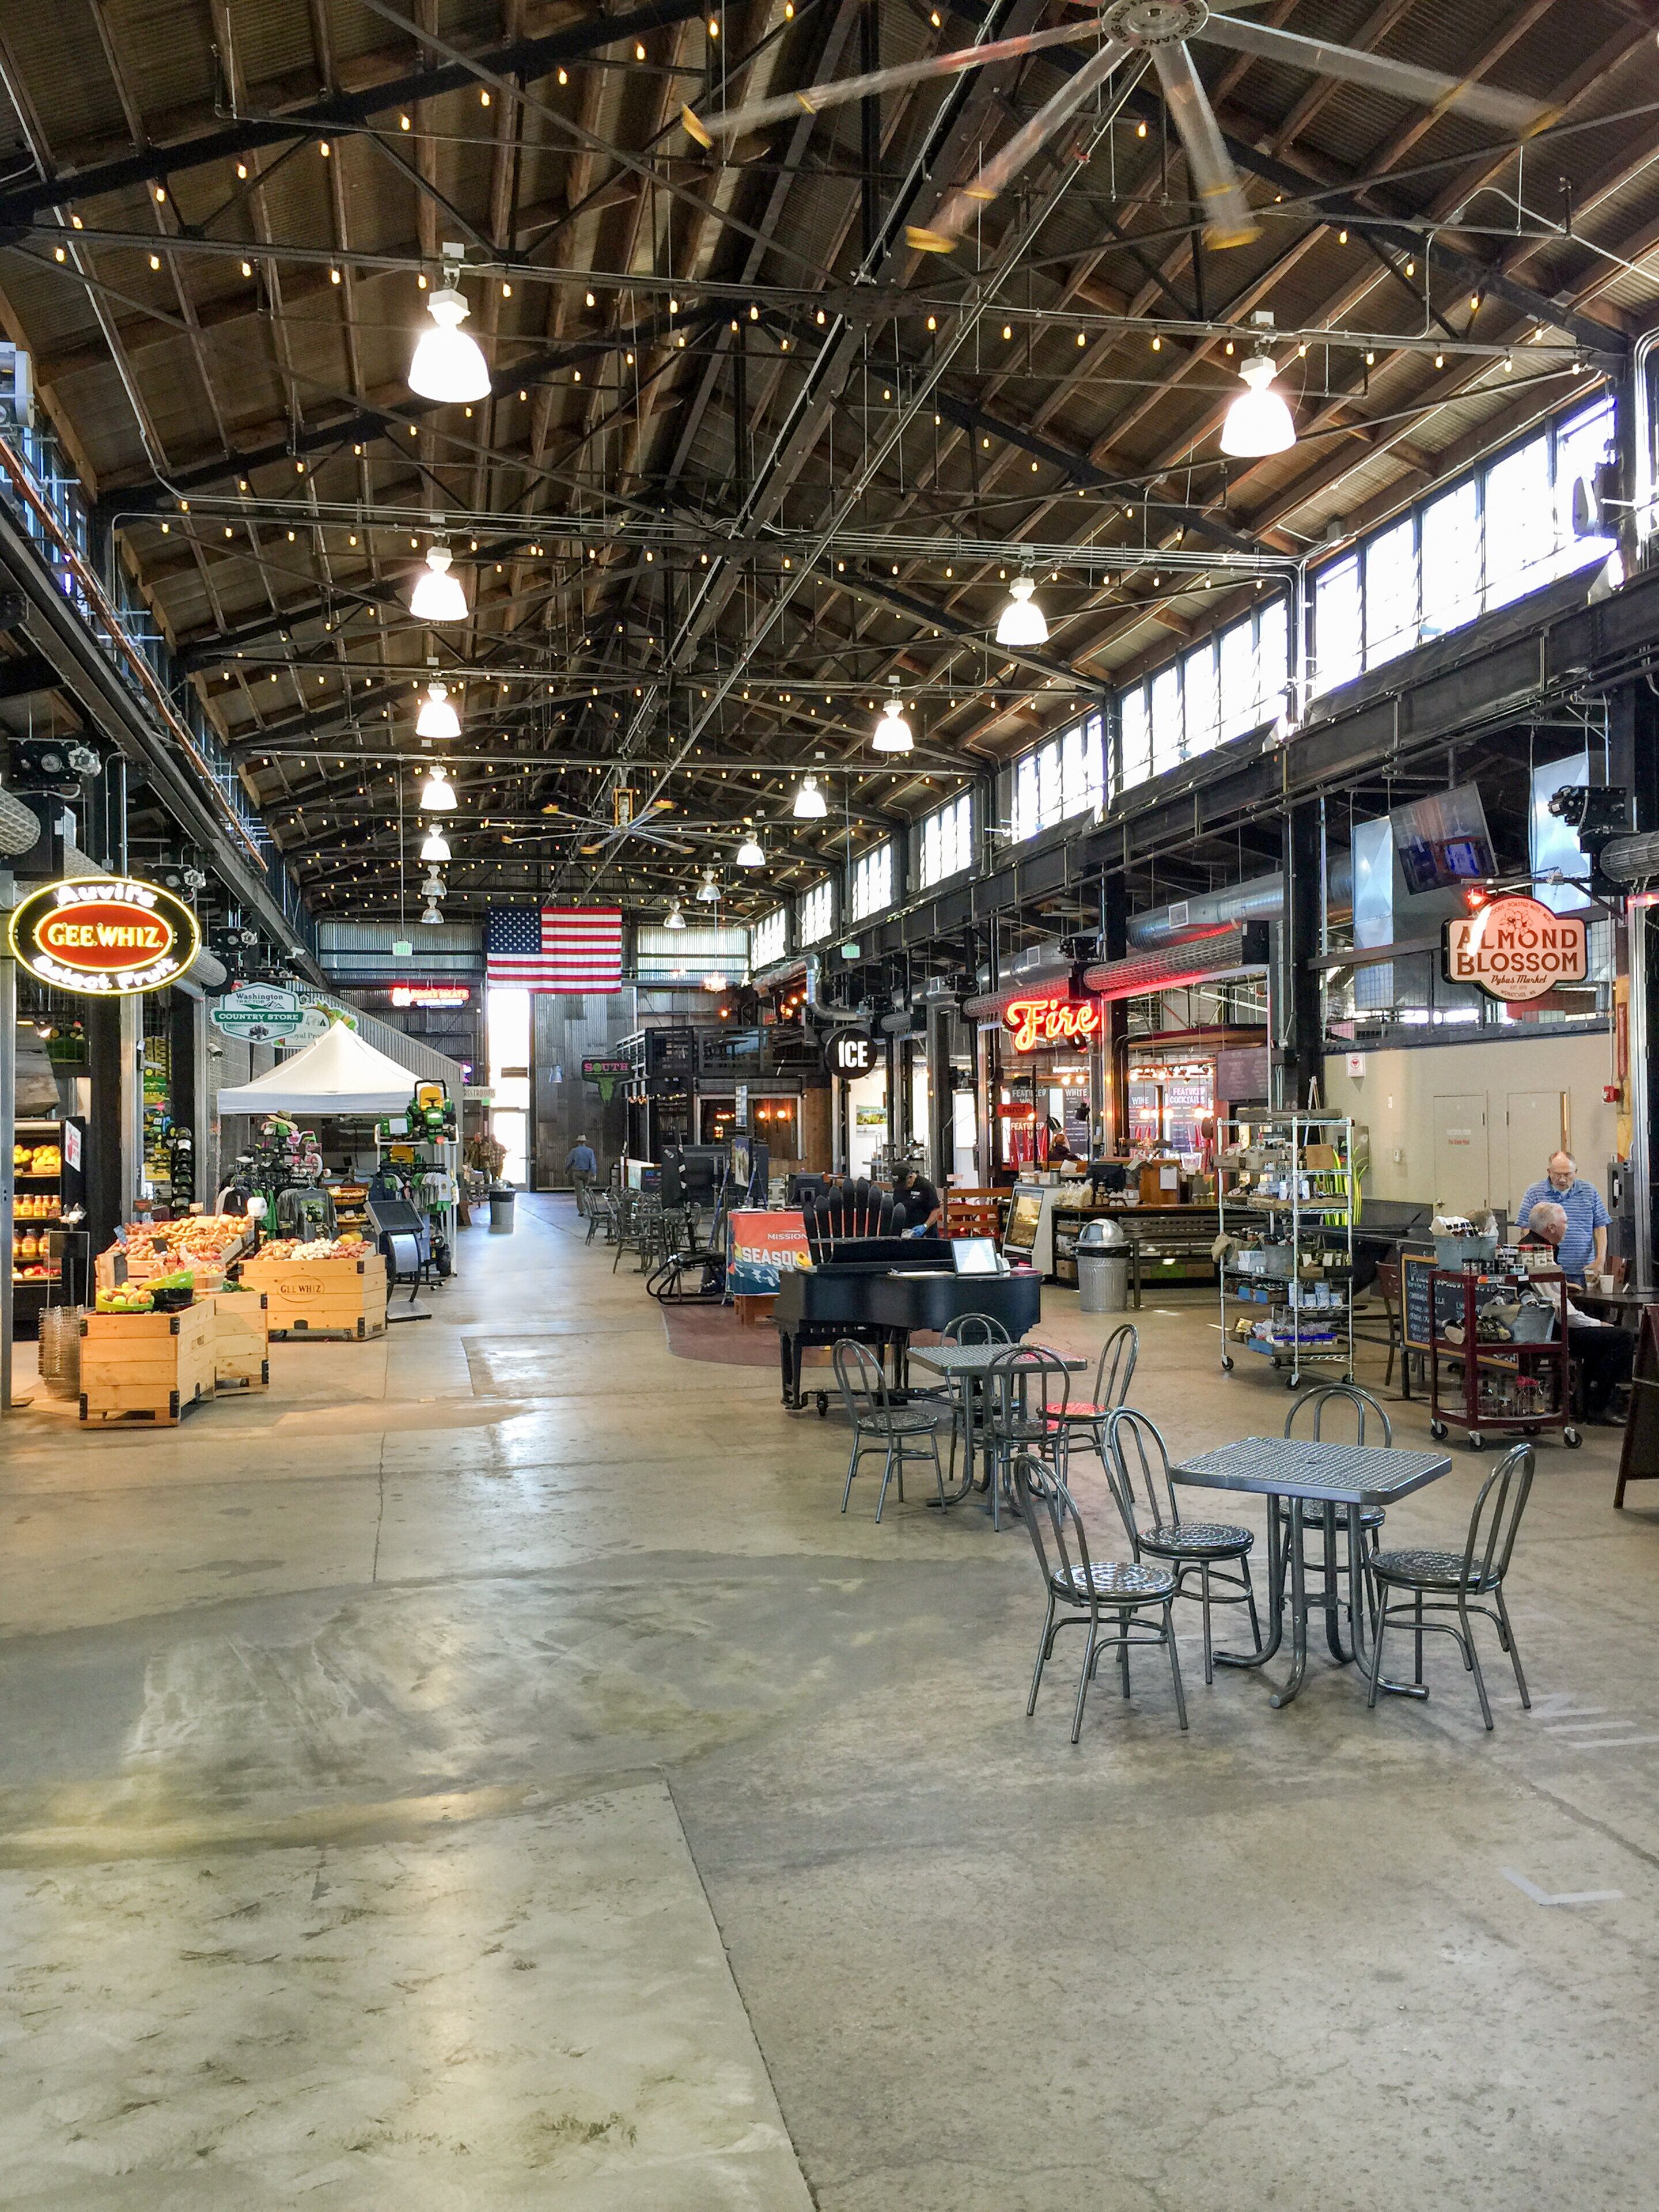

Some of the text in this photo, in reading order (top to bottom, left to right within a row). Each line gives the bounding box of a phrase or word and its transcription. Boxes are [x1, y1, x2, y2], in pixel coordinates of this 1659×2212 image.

[1179, 18, 1199, 35] ASS
[47, 922, 164, 948] GEE WHIZ
[1456, 926, 1578, 949] ALMOND
[1456, 952, 1578, 975] BLOSSOM
[1516, 975, 1547, 983] Market
[236, 993, 283, 1001] Washington
[267, 1012, 299, 1021] STORE
[1006, 999, 1099, 1051] Fire
[838, 1040, 868, 1068] ICE
[583, 1062, 629, 1072] SOUTH
[1065, 1088, 1088, 1097] WHITE
[1173, 1087, 1205, 1096] FEATURED
[1131, 1096, 1149, 1105] WINE
[1169, 1096, 1205, 1104] COCKTAILS
[1002, 1105, 1026, 1113] cured
[298, 1285, 321, 1293] WHIZ
